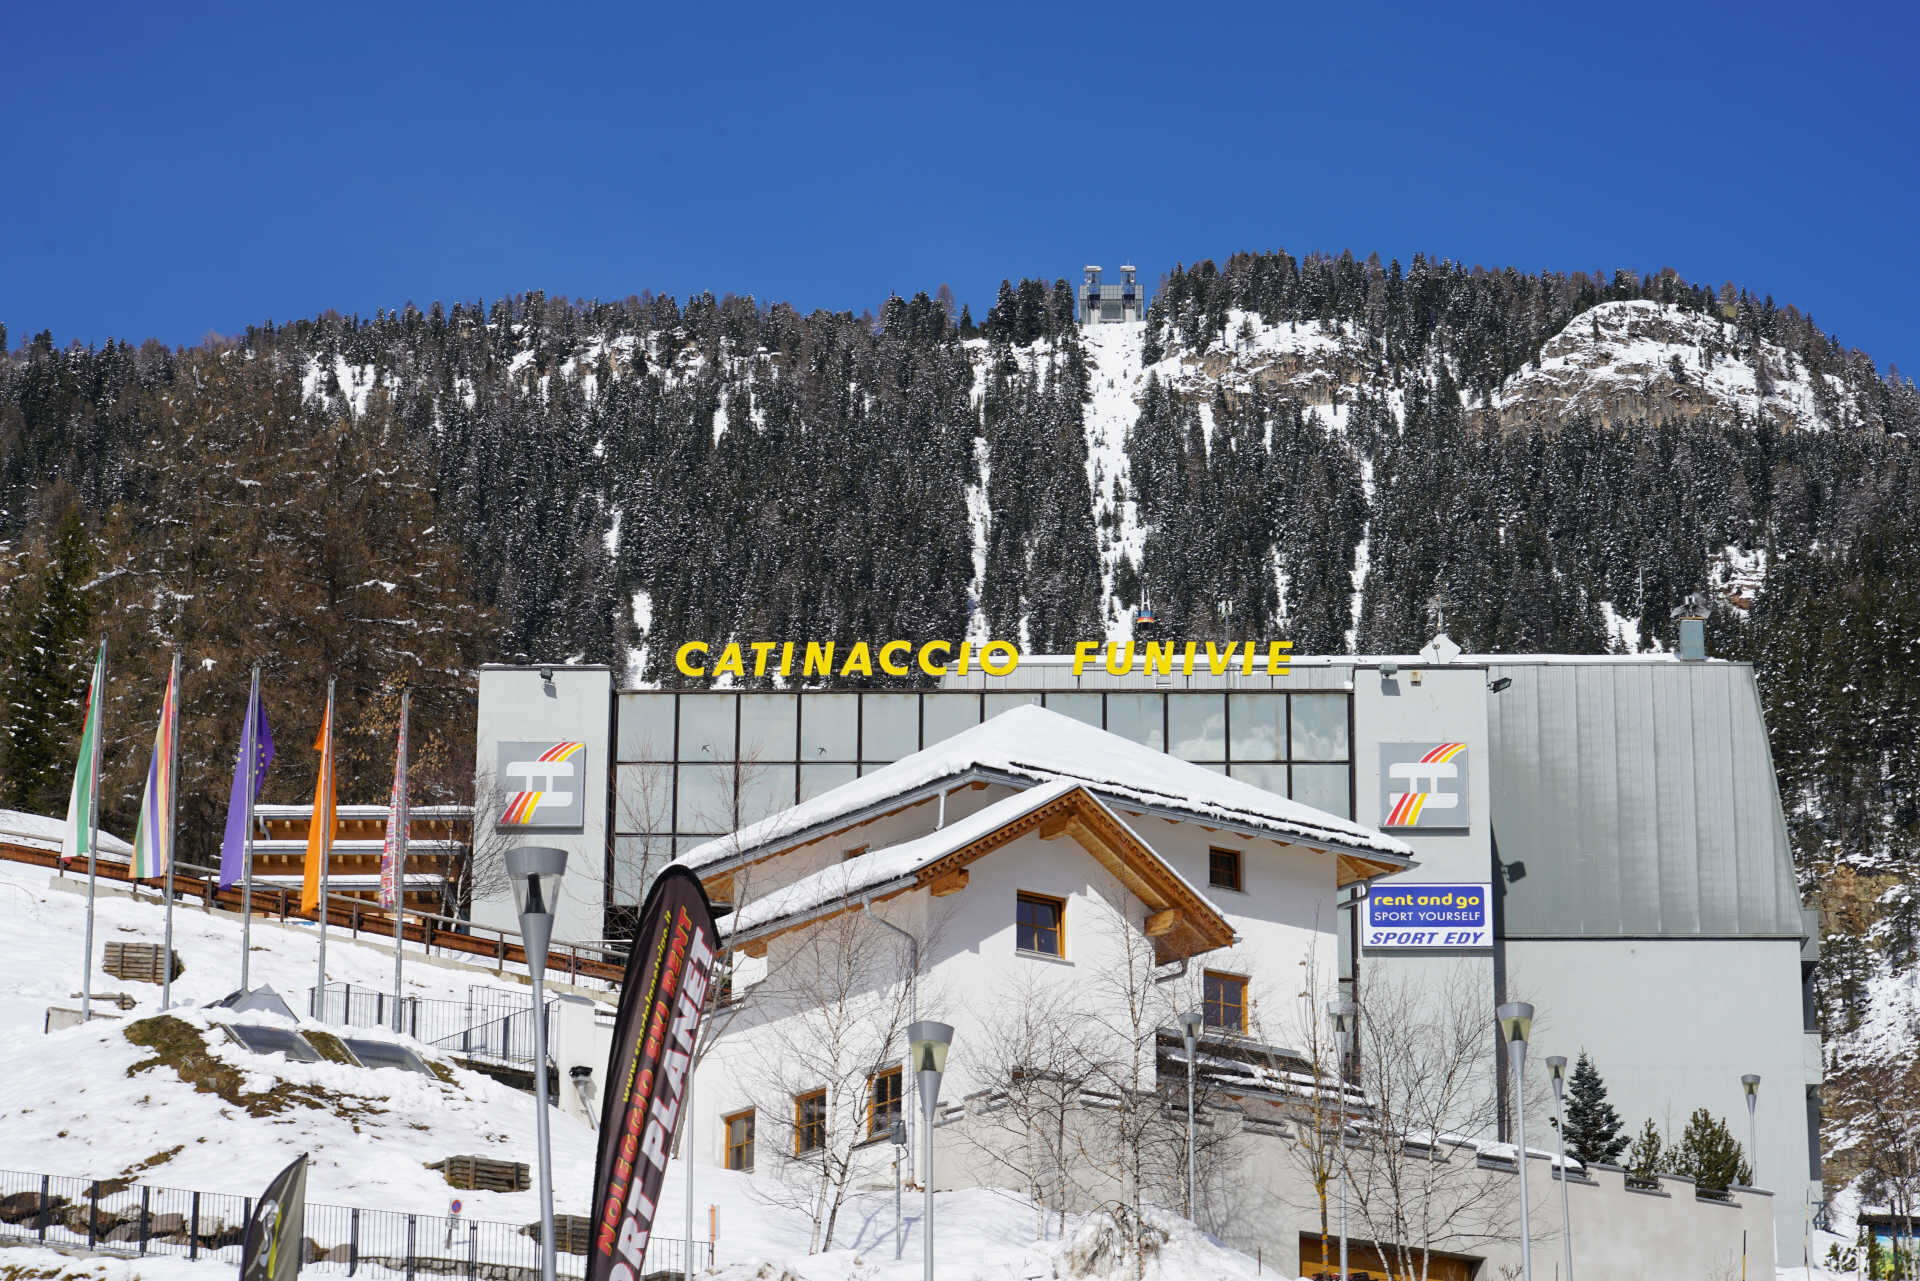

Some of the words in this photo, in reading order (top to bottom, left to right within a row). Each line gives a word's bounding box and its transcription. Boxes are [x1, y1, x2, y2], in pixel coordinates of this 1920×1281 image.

[675, 639, 1019, 677] CATINACCIO
[1072, 640, 1294, 676] FUNIVIE
[1374, 894, 1415, 906] rent
[1417, 893, 1453, 906] and
[1456, 896, 1480, 909] go
[1374, 911, 1415, 921] SPORT
[1418, 911, 1481, 921] YOURSELF
[1370, 931, 1439, 944] SPORT
[1444, 931, 1485, 944] EDY
[641, 925, 714, 1173] PLANET
[597, 1068, 654, 1257] NOLEGGIO
[645, 1000, 670, 1064] SKI
[661, 905, 693, 999] RENT
